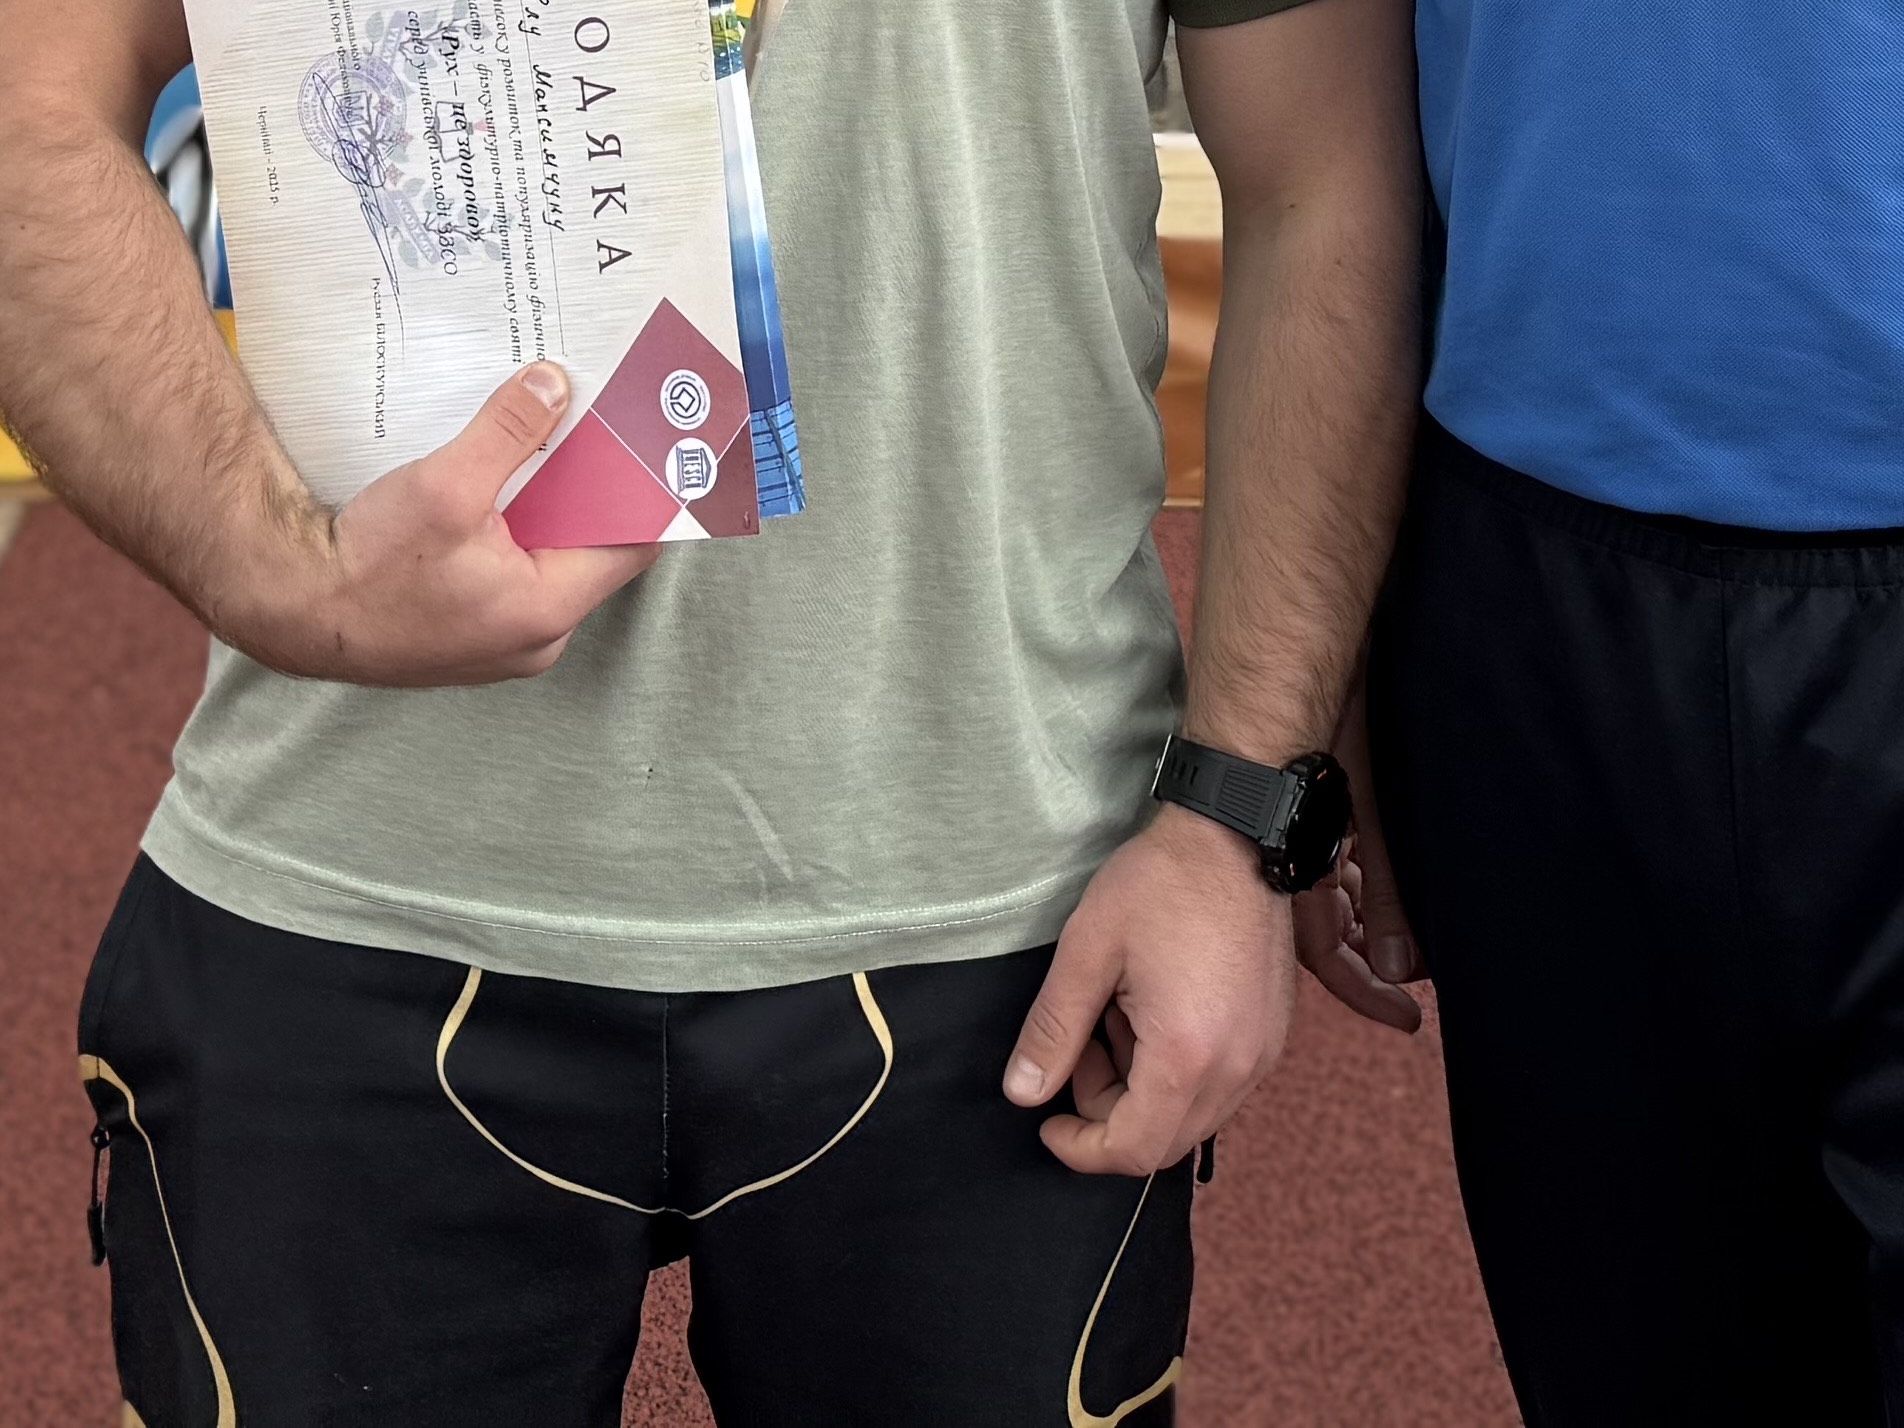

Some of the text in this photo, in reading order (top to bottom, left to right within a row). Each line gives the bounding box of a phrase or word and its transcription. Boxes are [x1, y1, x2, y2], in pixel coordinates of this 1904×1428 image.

[327, 12, 344, 43] Юрія
[403, 9, 429, 56] серед
[412, 60, 441, 151] учнівської
[447, 102, 468, 131] це
[496, 57, 521, 139] розвиток
[511, 139, 524, 161] та
[427, 154, 452, 218] молоді
[451, 135, 488, 243] здорово»
[469, 44, 483, 55] у
[505, 316, 526, 365] святі
[513, 166, 541, 290] популяризацію
[526, 292, 550, 362] фізично
